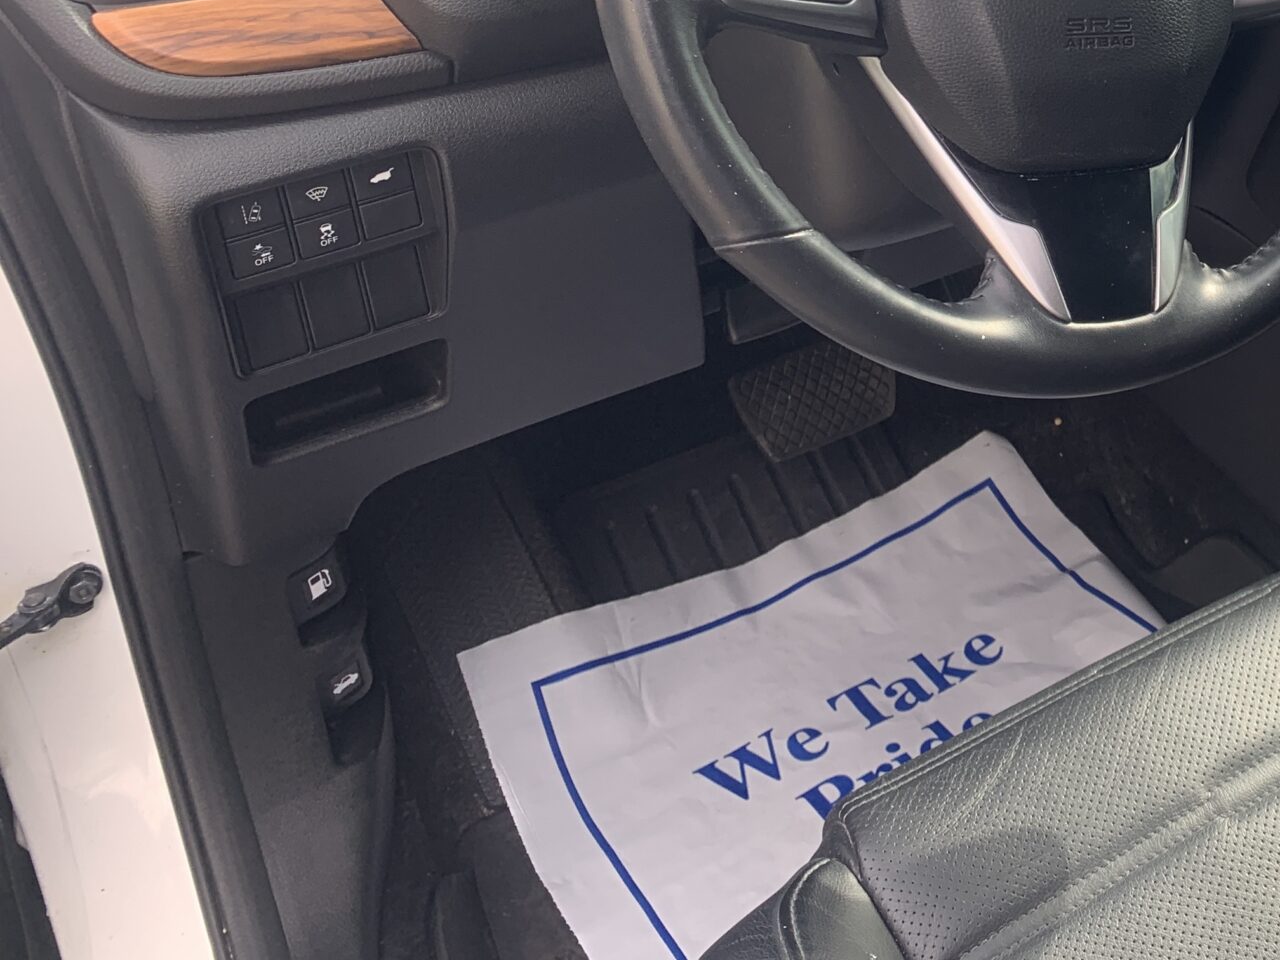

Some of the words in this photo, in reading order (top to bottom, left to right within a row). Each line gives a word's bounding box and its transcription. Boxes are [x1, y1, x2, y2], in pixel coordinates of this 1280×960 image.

[1064, 17, 1133, 34] SRS
[1065, 36, 1136, 50] AIRBAG
[320, 236, 338, 247] OFF
[255, 255, 274, 266] OFF
[693, 726, 830, 800] We
[827, 633, 1004, 730] Take
